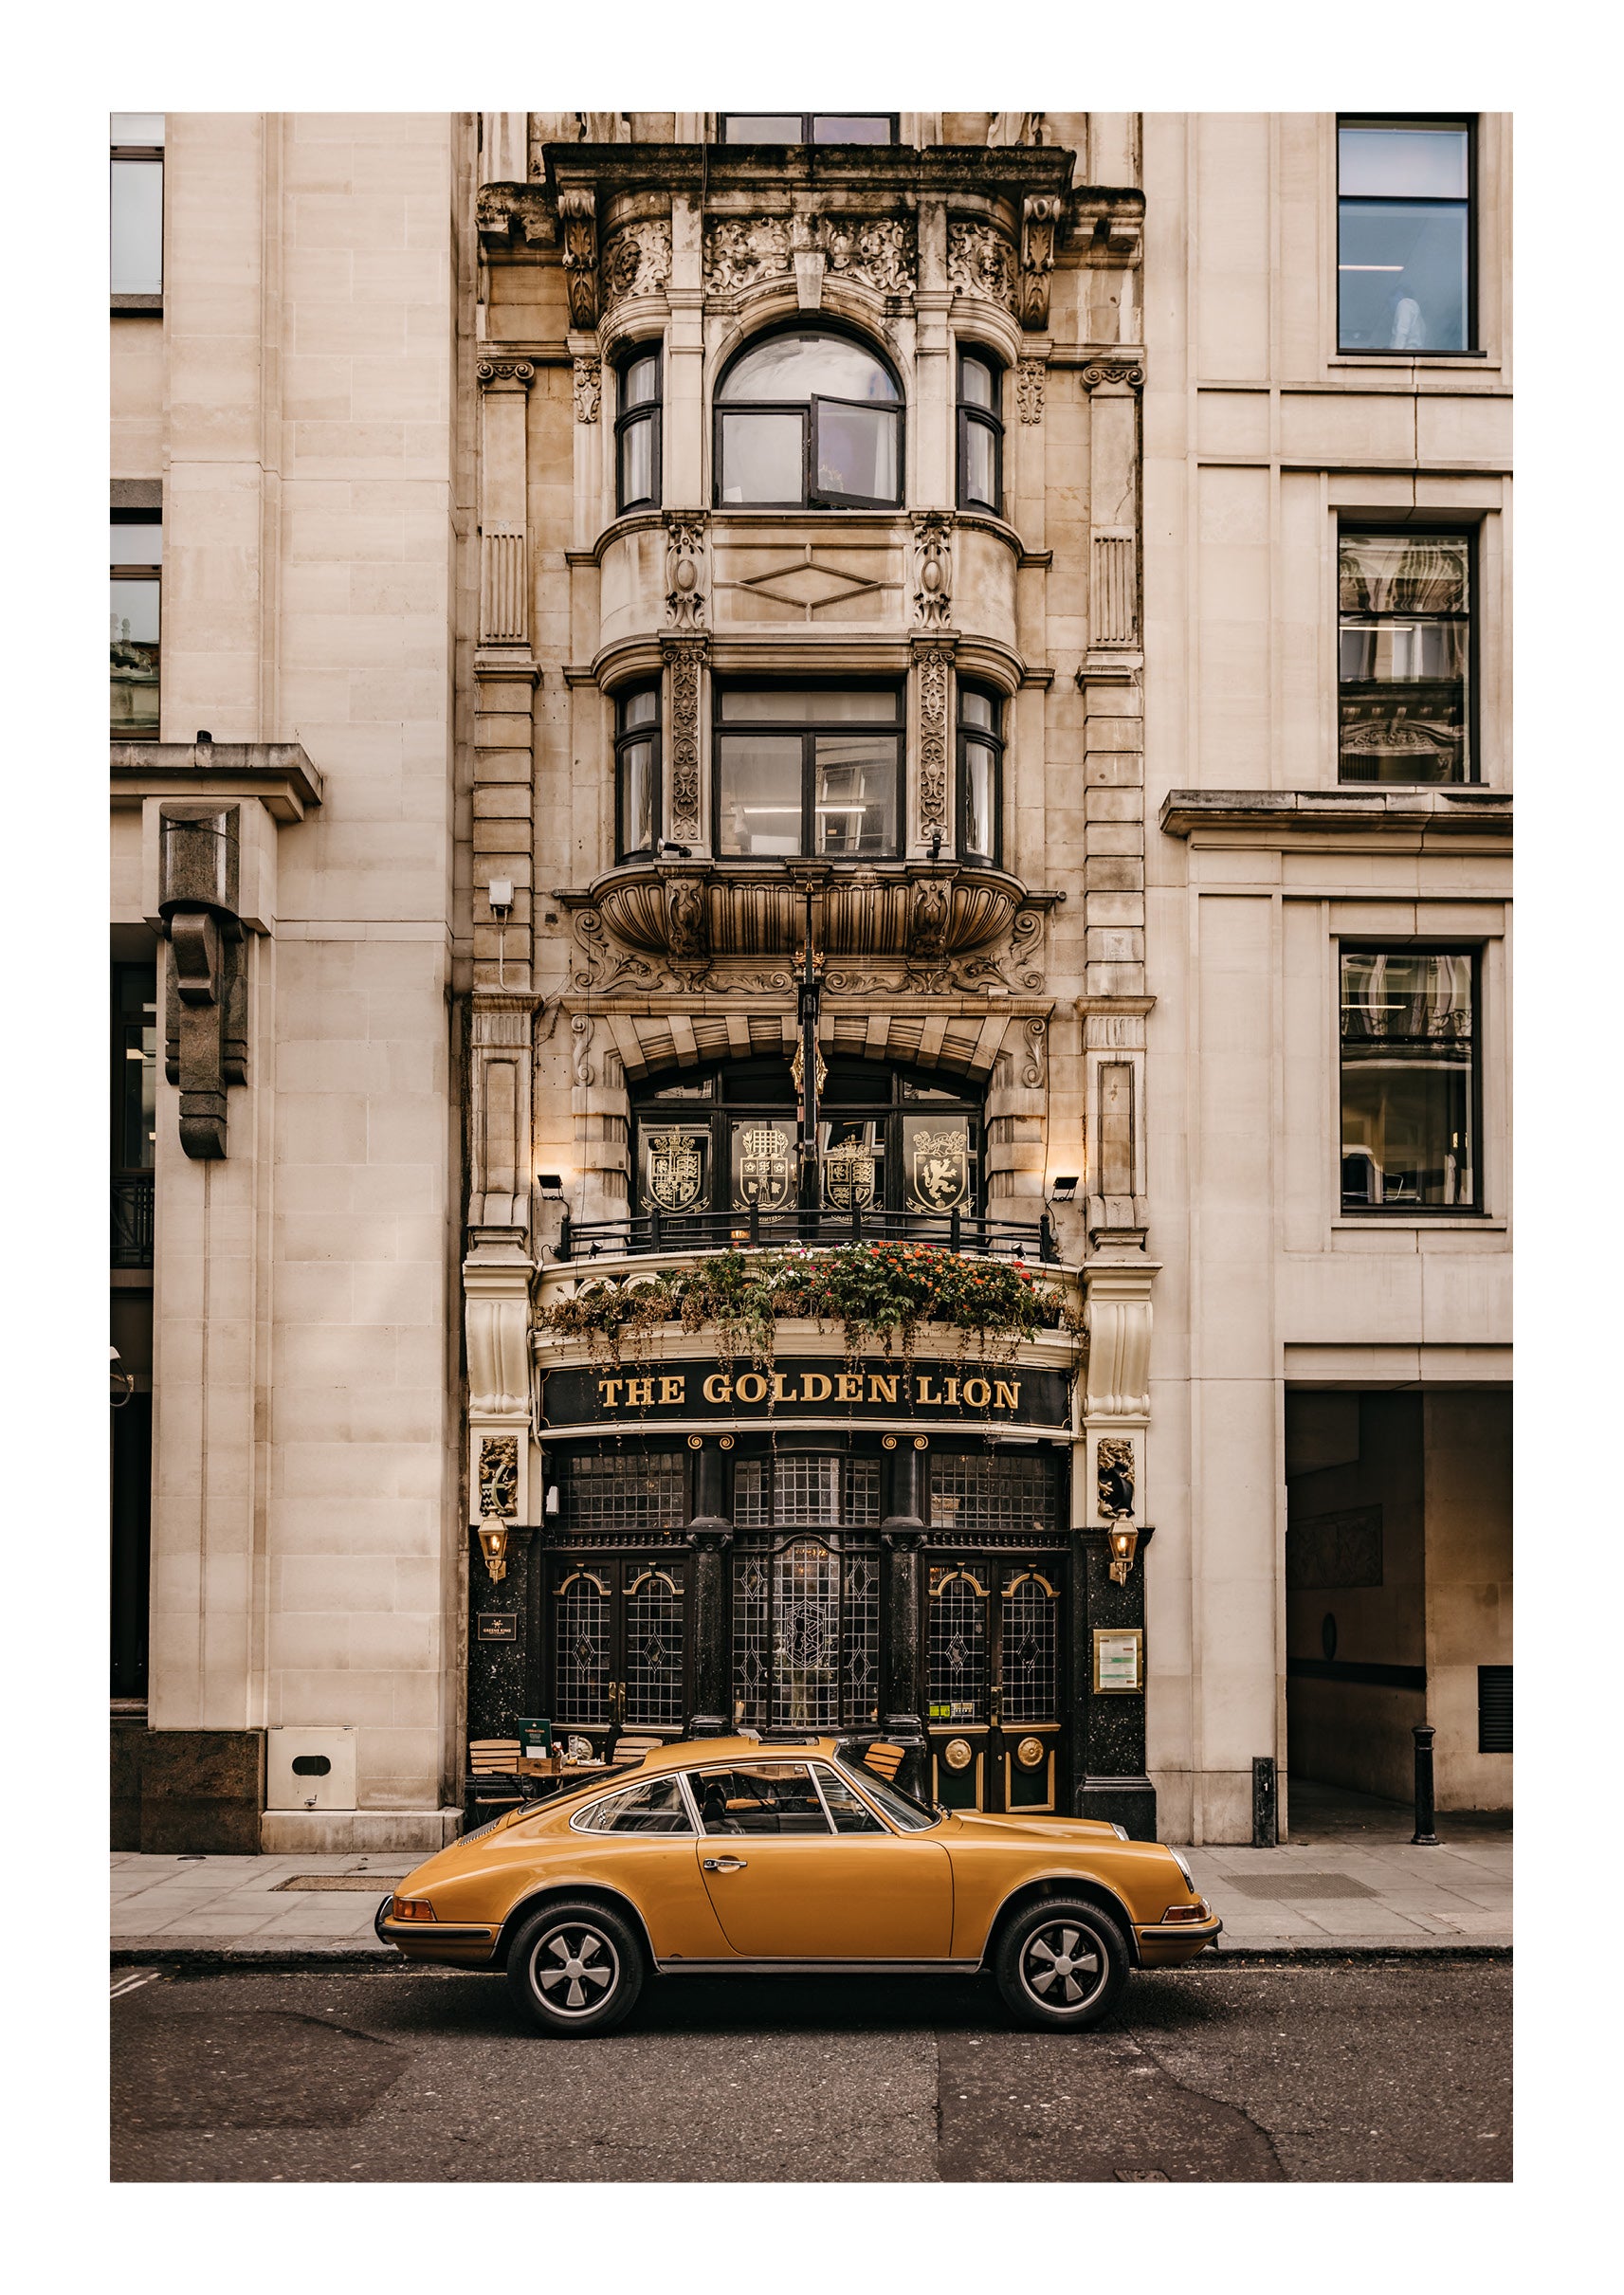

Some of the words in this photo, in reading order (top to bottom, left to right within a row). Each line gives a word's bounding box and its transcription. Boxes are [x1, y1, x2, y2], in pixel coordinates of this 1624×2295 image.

[598, 1375, 685, 1408] THE
[703, 1374, 900, 1403] GOLDEN
[916, 1376, 1022, 1410] LION
[1264, 1782, 1268, 1792] 1
